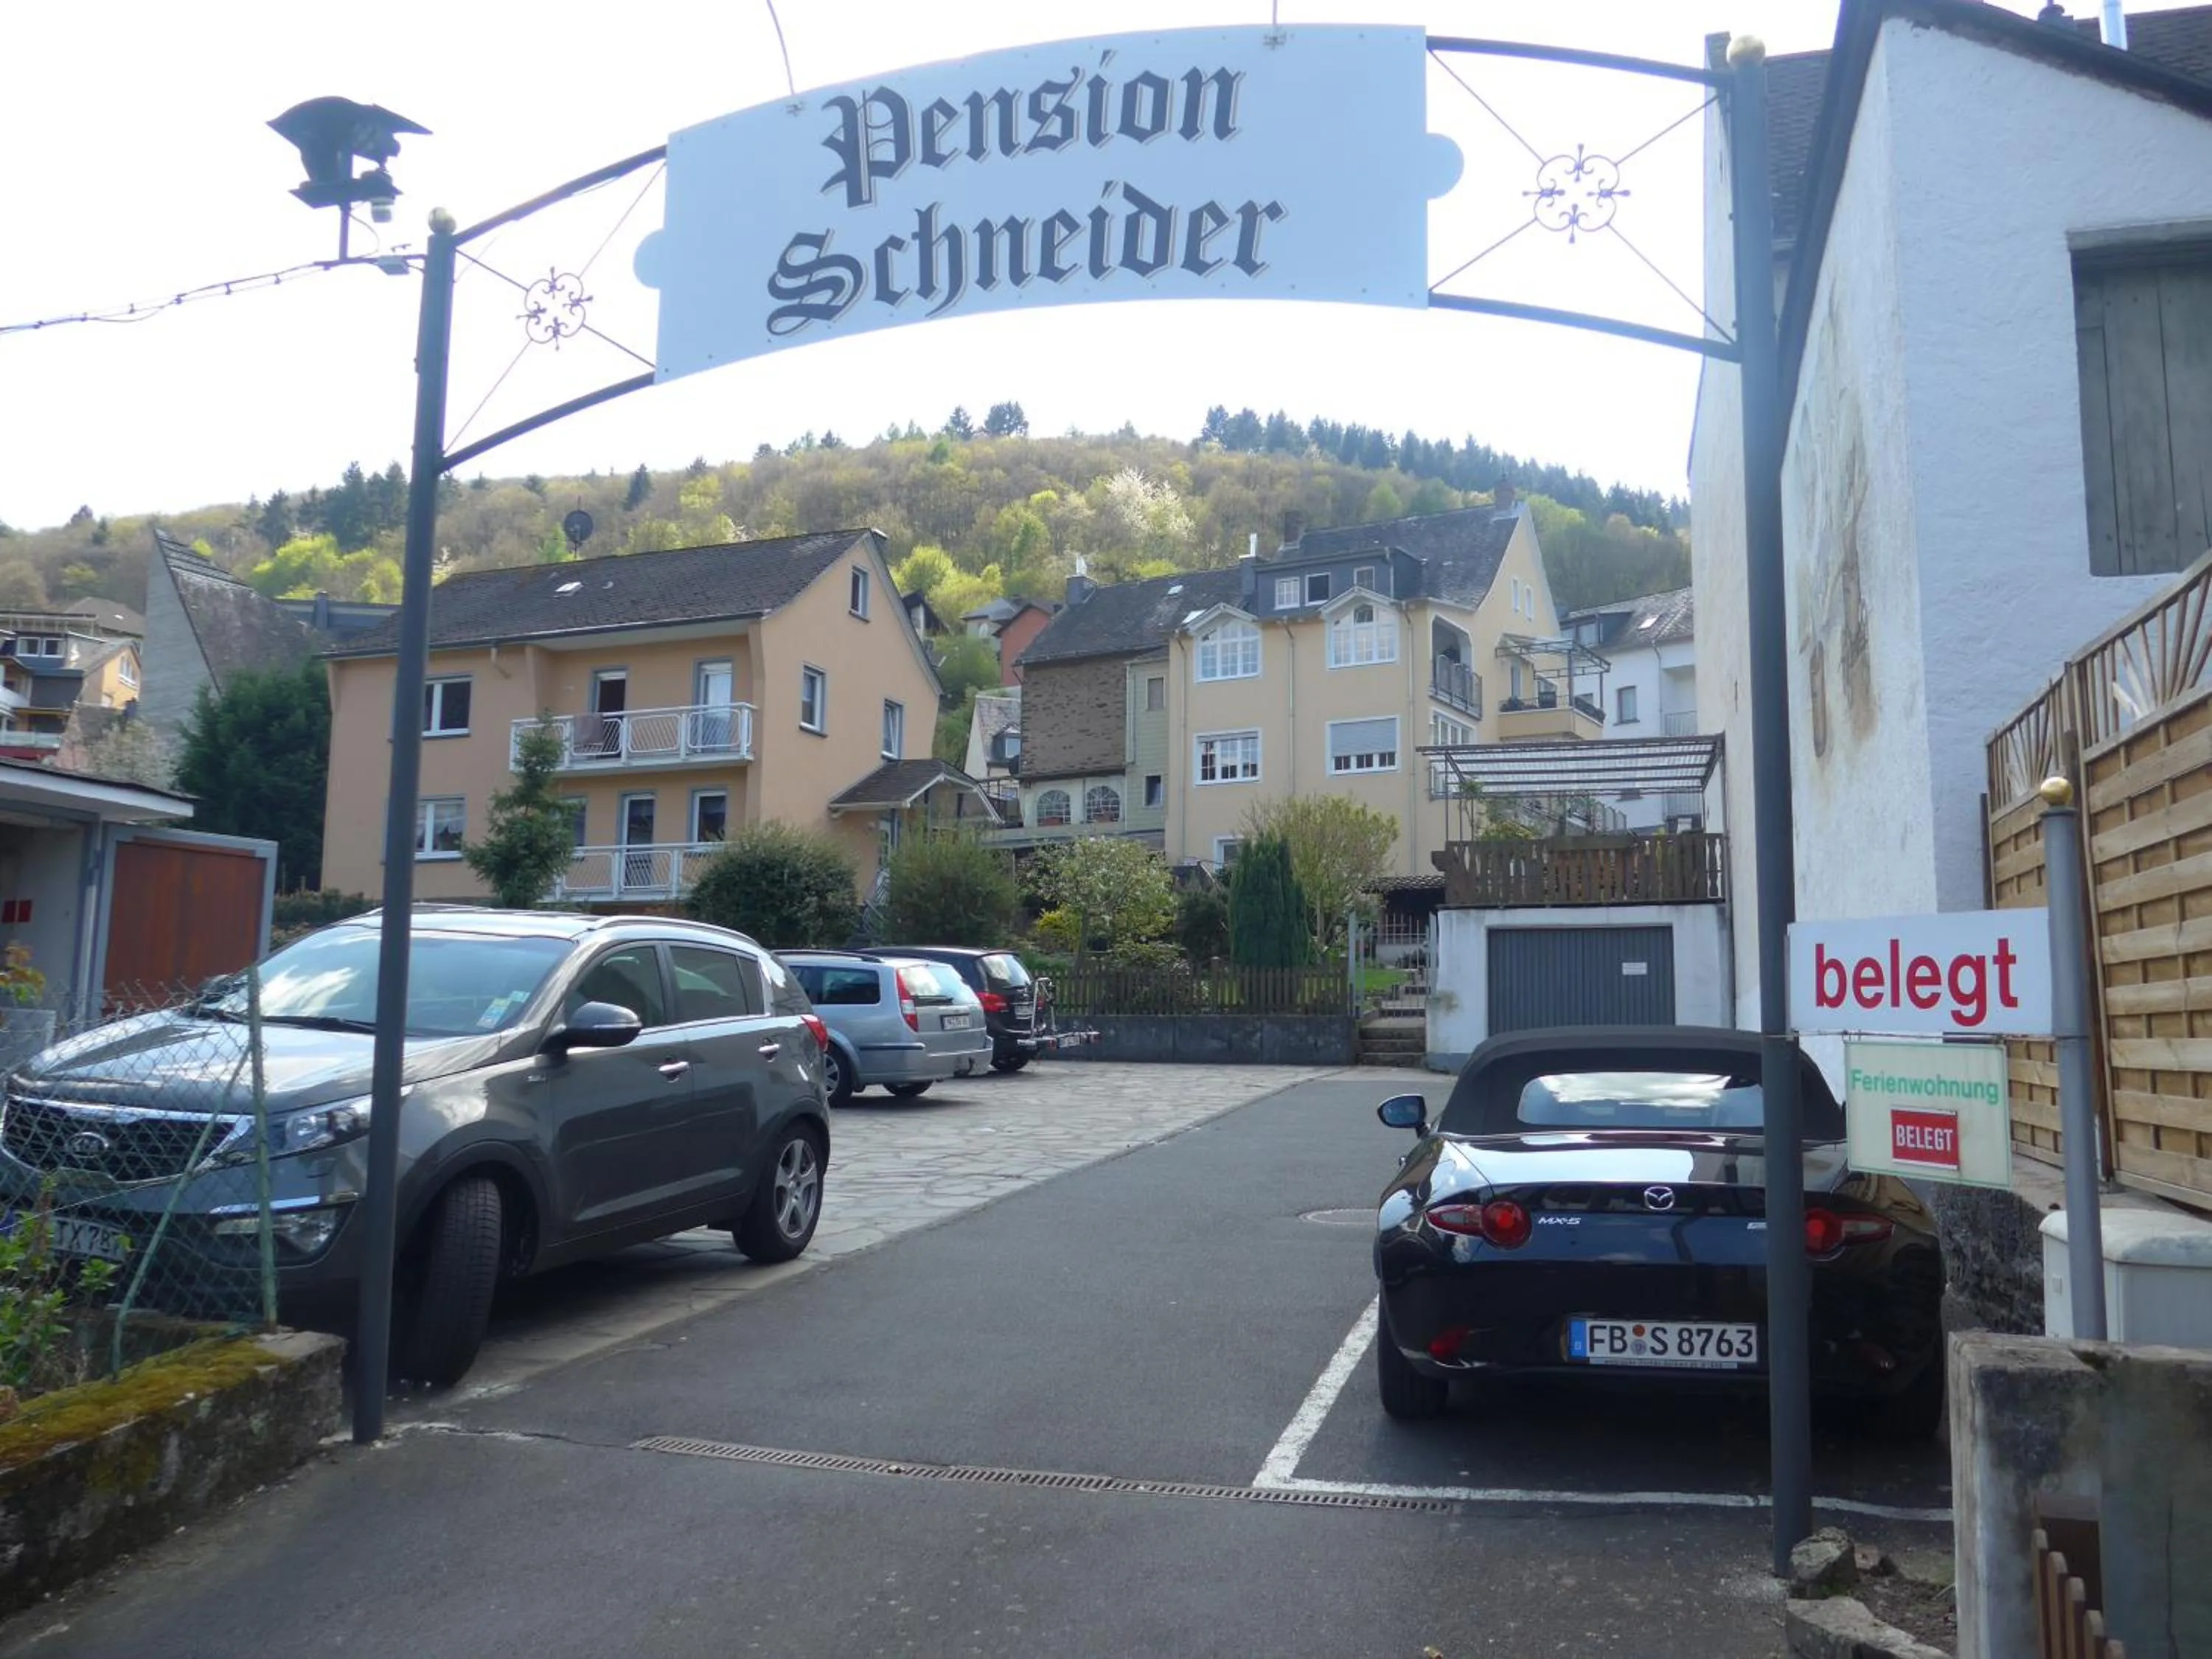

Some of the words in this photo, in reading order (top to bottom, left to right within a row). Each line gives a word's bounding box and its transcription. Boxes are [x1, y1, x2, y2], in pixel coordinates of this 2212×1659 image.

[820, 49, 1247, 209] Pension
[766, 180, 1287, 338] Schneider
[1815, 938, 2018, 1027] belegt
[1851, 1069, 1999, 1105] Ferienwohnung
[1896, 1124, 1953, 1152] BELEGT
[1589, 1325, 1628, 1354] FB
[1649, 1326, 1669, 1356] S
[1677, 1327, 1753, 1358] 8763
